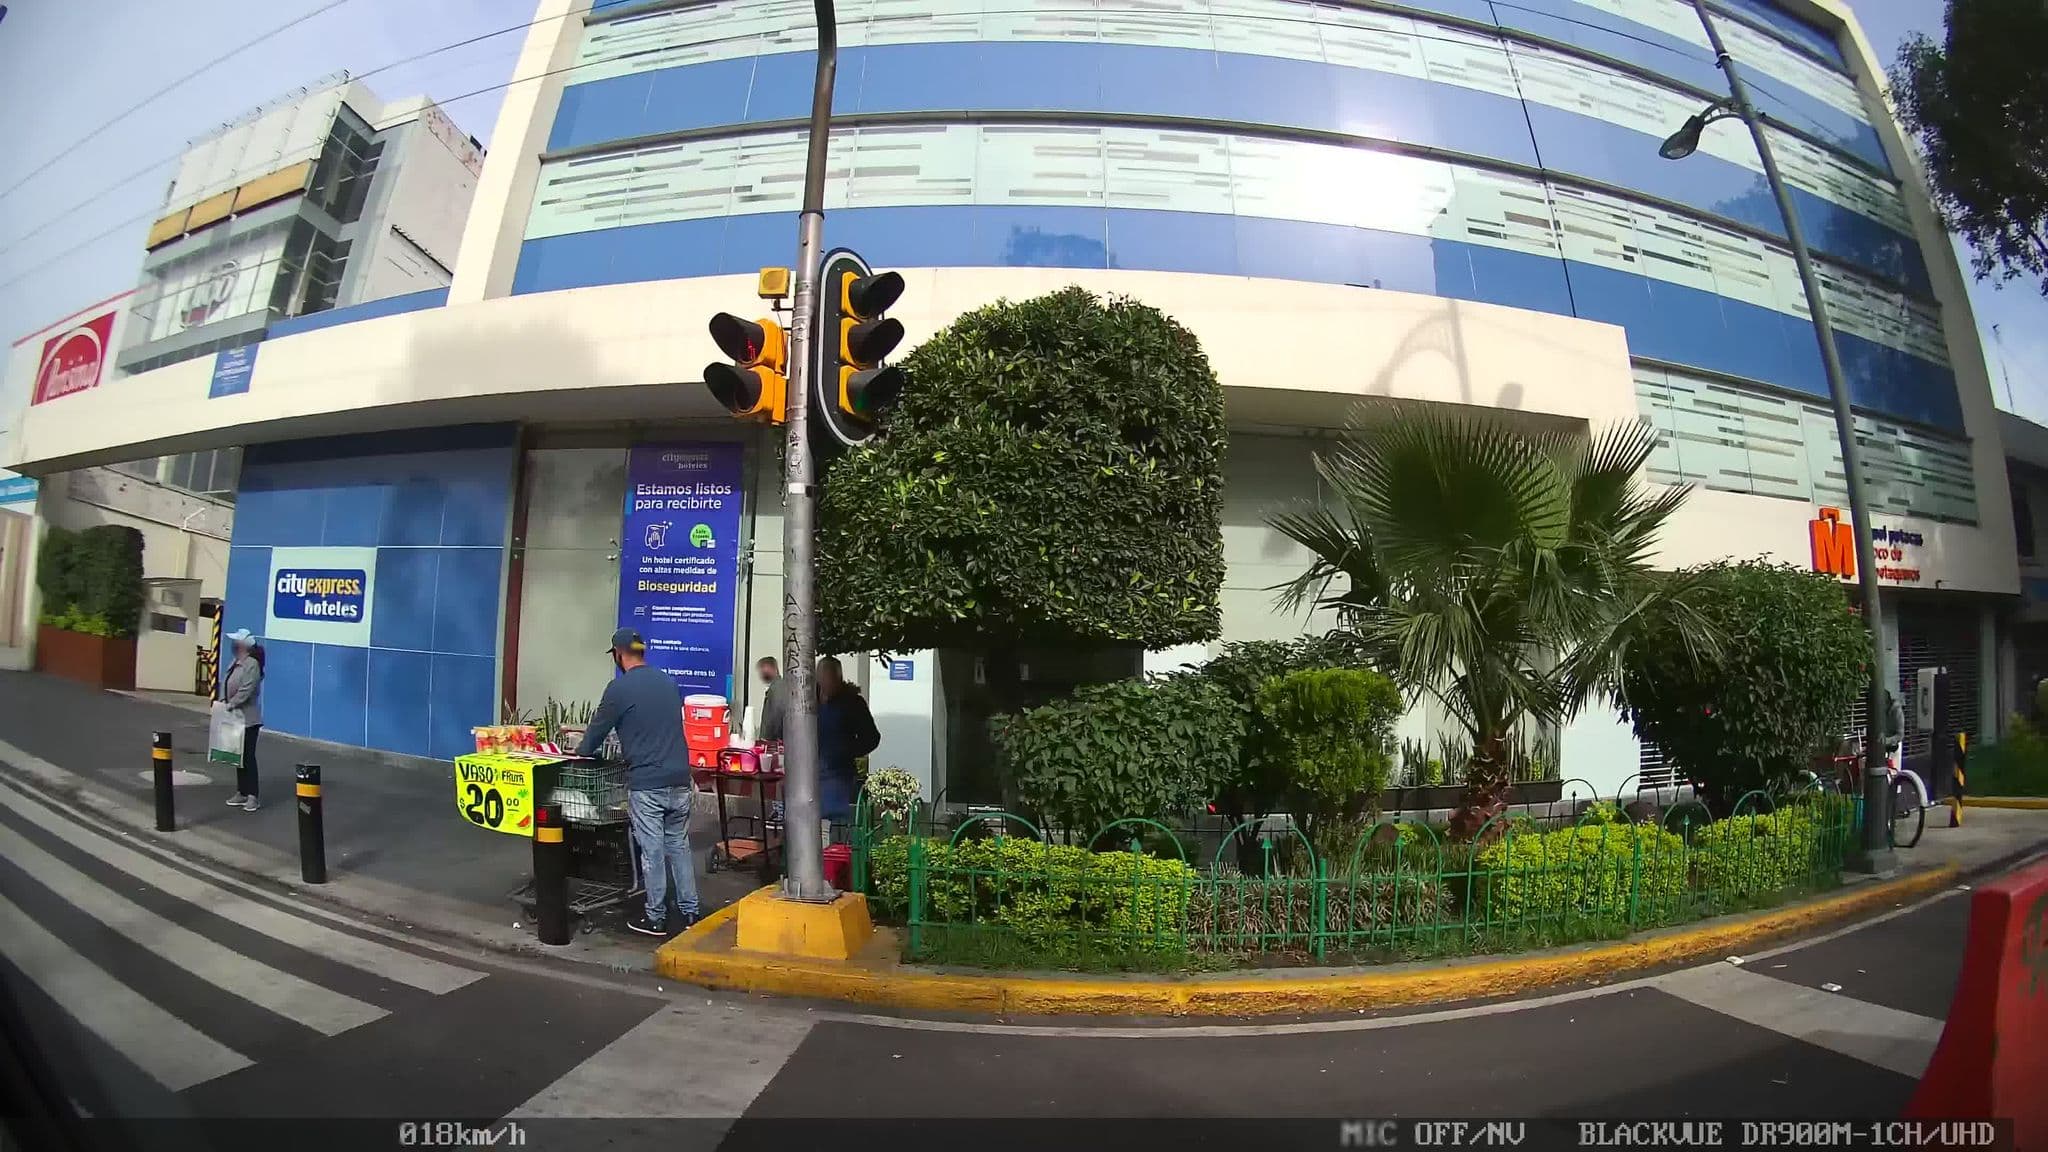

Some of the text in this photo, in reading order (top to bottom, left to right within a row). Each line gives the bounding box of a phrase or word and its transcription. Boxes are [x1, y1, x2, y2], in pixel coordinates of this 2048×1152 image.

[636, 482, 732, 496] Estamos listos
[635, 496, 722, 512] para recibirte
[642, 556, 715, 565] Un hotel certificado
[654, 566, 671, 574] altas
[673, 567, 705, 575] medidas
[706, 567, 717, 575] de
[638, 580, 717, 593] Bioseguridad
[304, 599, 358, 618] hoteles
[459, 762, 493, 783] VASO
[502, 771, 524, 783] FRUTA
